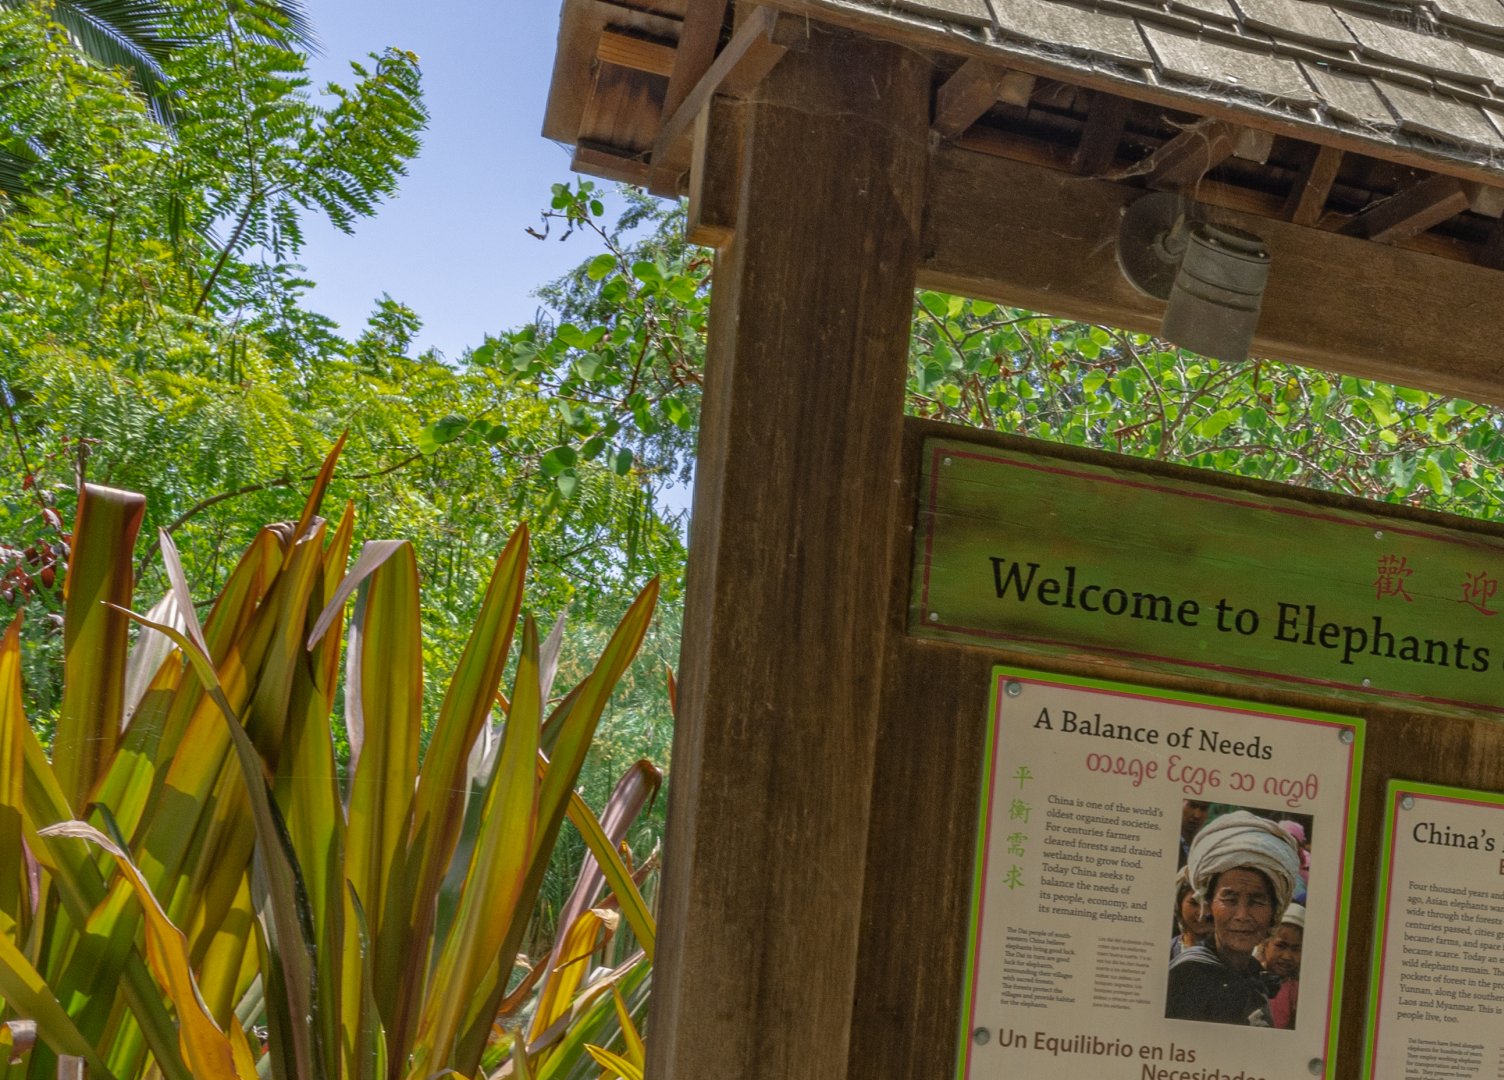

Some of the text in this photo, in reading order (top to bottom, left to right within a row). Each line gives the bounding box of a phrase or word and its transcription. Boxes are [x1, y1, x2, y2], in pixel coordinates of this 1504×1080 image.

[988, 556, 1199, 626] Welcome
[1214, 598, 1259, 635] to
[1273, 601, 1489, 672] Elephants
[1033, 707, 1272, 760] A Balance of Needs
[1047, 793, 1163, 817] China is one of the world's
[1046, 807, 1160, 830] oldest organized societies.
[1044, 820, 1140, 841] For centuries farmers
[1412, 822, 1494, 851] China's
[1043, 834, 1162, 858] cleared forests and drained
[1042, 849, 1143, 868] wetlands to grow food.
[1041, 862, 1135, 881] Today China seeks to
[1040, 875, 1131, 894] balance the needs of
[1408, 880, 1428, 891] Four
[1428, 882, 1467, 895] thousand
[1467, 889, 1489, 898] years
[1489, 890, 1504, 900] and
[1039, 889, 1147, 910] its people, economy, and
[1406, 895, 1424, 905] ago,
[1424, 895, 1448, 906] Asian
[1449, 898, 1488, 910] elephants
[1038, 903, 1144, 923] its remaining elephants.
[1405, 906, 1425, 916] wide
[1426, 908, 1459, 922] through
[1460, 912, 1474, 922] the
[1475, 913, 1502, 925] forests
[1404, 921, 1442, 931] centuries
[1442, 925, 1472, 936] passed,
[1473, 927, 1496, 937] cities
[1403, 931, 1434, 943] became
[1435, 935, 1461, 947] farms,
[1462, 939, 1478, 948] and
[1479, 942, 1501, 951] space
[1402, 944, 1433, 956] became
[1434, 950, 1460, 959] scarce.
[1462, 950, 1487, 964] Today
[998, 1028, 1195, 1063] Un Equilibrio en las
